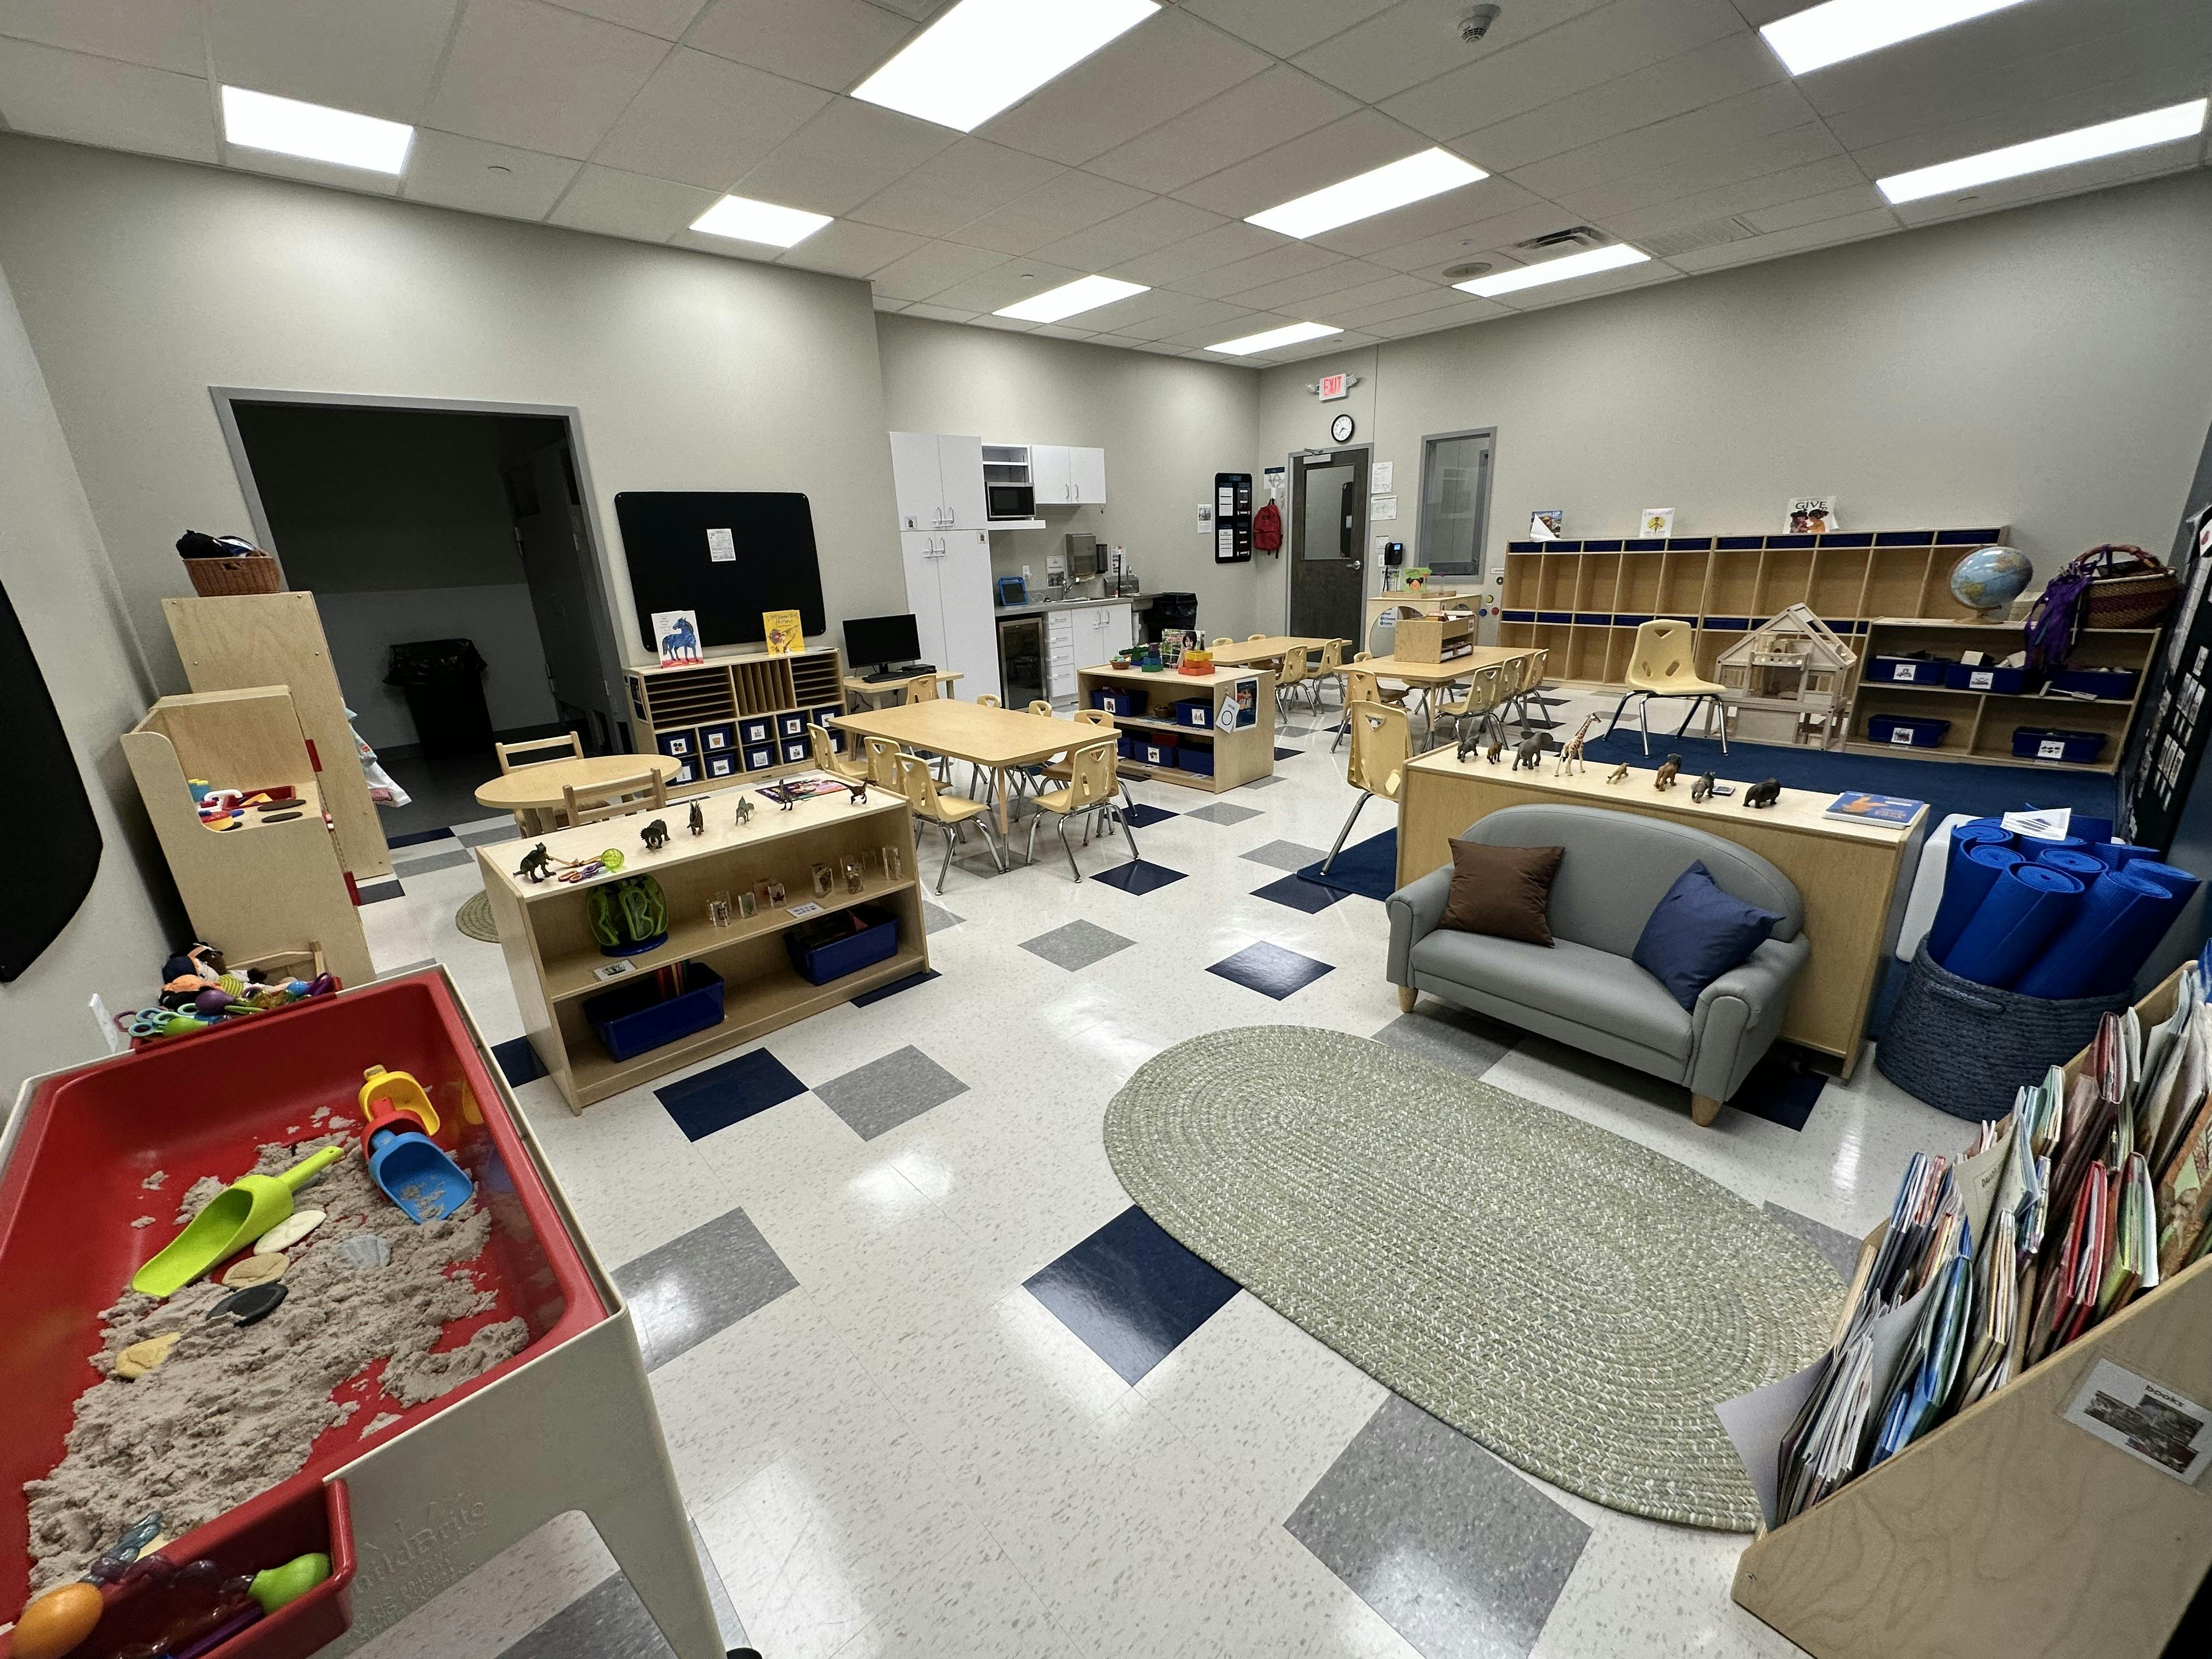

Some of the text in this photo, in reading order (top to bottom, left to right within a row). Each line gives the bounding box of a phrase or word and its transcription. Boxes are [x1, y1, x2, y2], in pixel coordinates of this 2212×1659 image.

[1323, 376, 1342, 396] EXIT
[1795, 501, 1827, 510] GIVE
[2145, 1384, 2185, 1407] books
[353, 1501, 485, 1594] hildBrite
